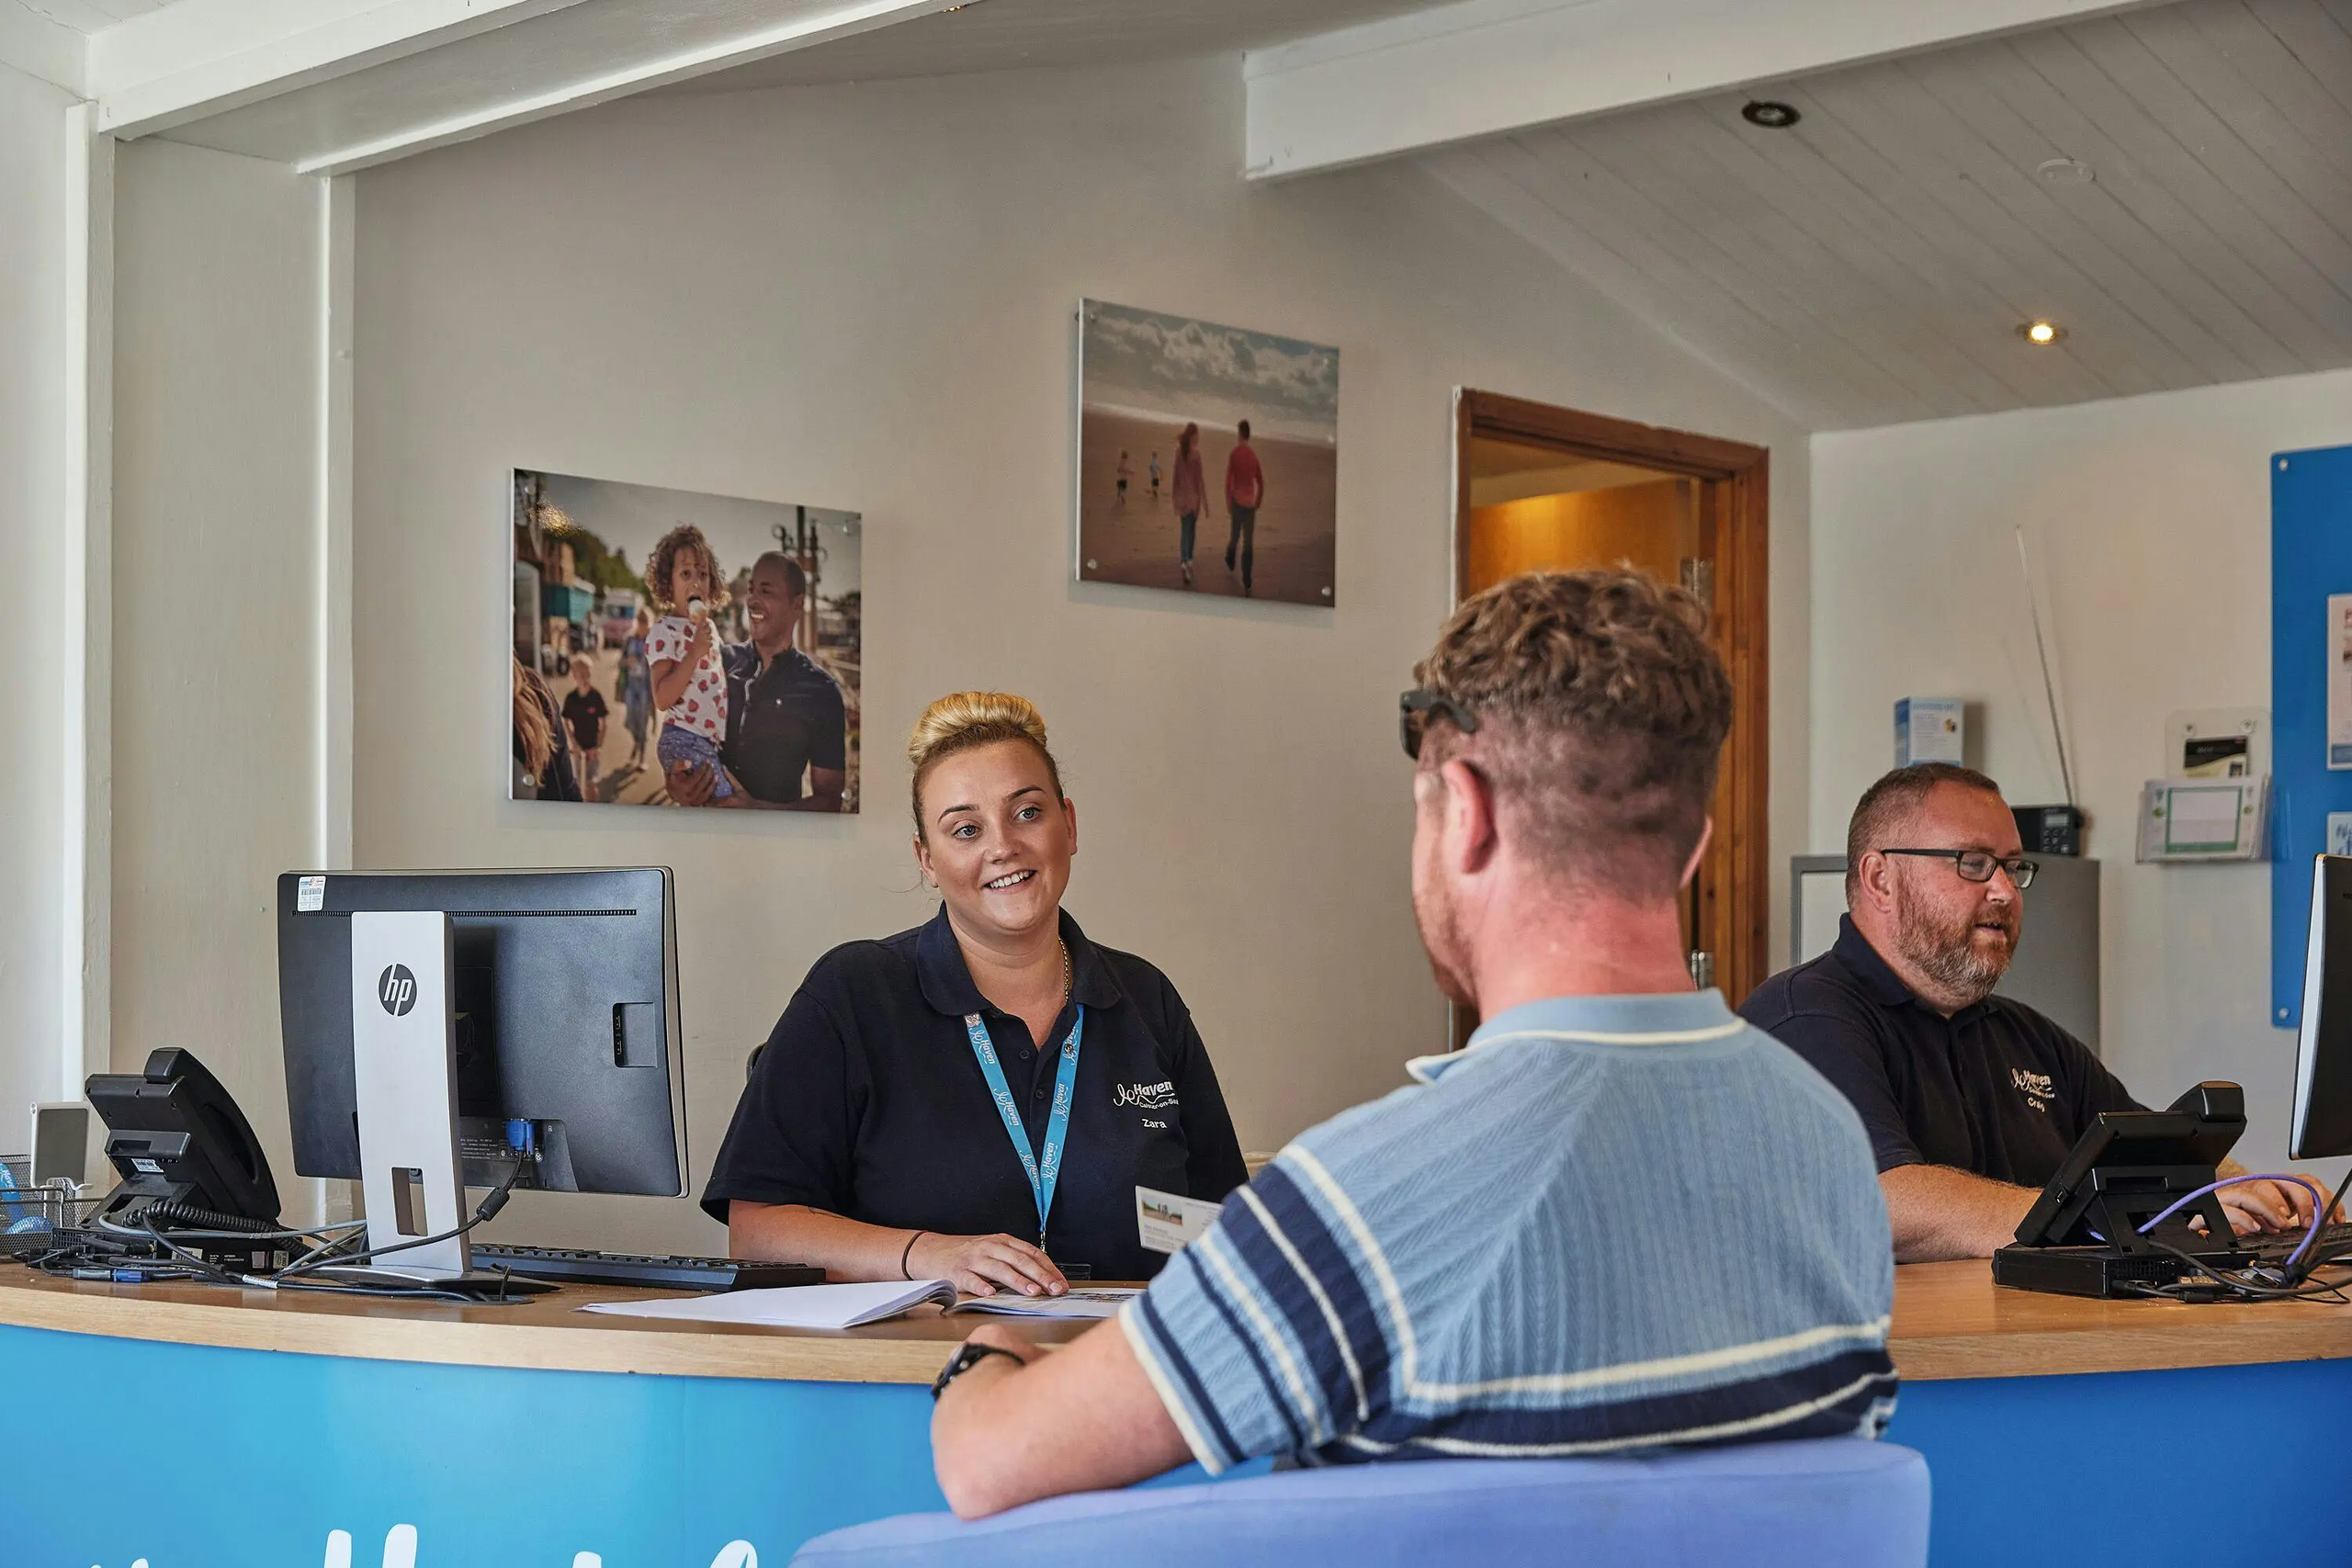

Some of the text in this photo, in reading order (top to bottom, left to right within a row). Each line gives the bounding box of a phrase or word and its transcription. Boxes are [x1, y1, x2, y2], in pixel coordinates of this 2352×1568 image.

[381, 964, 413, 1017] hp
[981, 1040, 996, 1064] Haven
[1054, 1083, 1065, 1105] Haven
[1133, 1081, 1173, 1096] Haven
[1006, 1101, 1020, 1126] Haven
[1141, 1118, 1168, 1129] Zara
[1042, 1142, 1055, 1169] Haven
[1029, 1164, 1041, 1190] Haven
